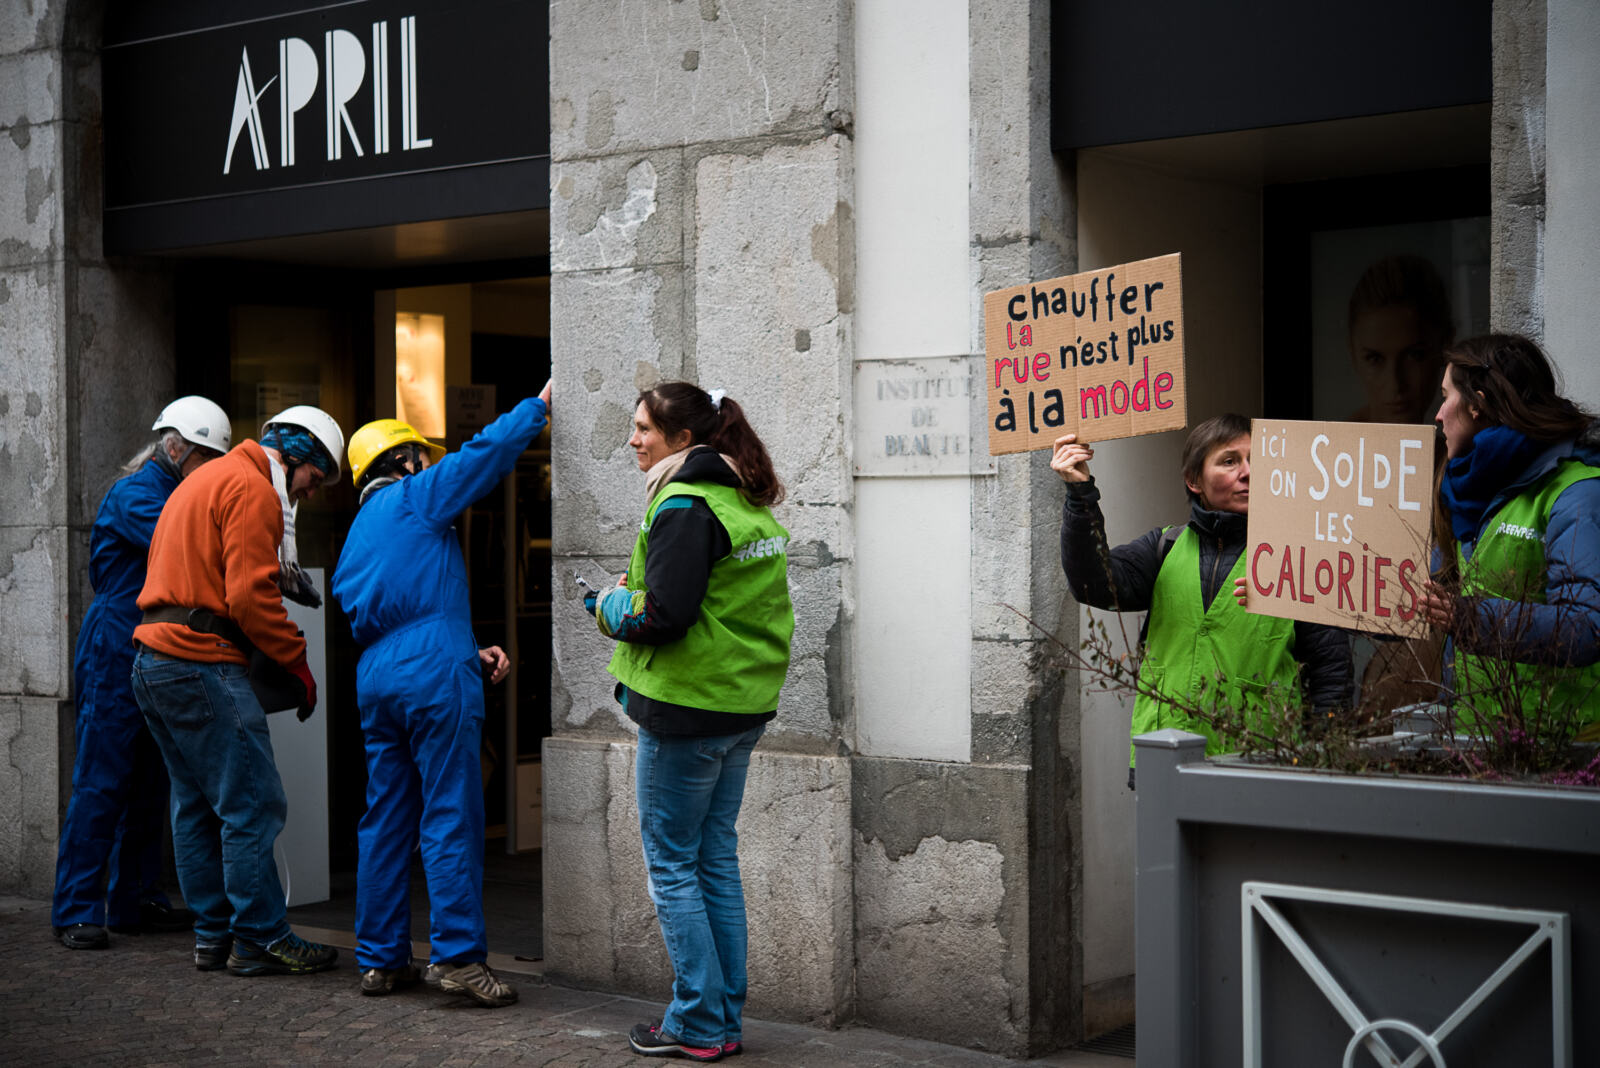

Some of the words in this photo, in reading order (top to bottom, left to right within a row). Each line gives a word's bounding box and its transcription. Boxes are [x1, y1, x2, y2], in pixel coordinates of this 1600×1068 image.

[223, 16, 433, 175] APRIL
[1008, 273, 1164, 321] chauffer
[994, 352, 1051, 388] rue
[1059, 331, 1119, 370] n'est
[1127, 315, 1174, 366] plus
[1006, 321, 1033, 350] la
[1028, 388, 1065, 434] la
[1080, 356, 1174, 419] mode
[1269, 468, 1297, 499] ON
[1308, 433, 1423, 512] SOLDE
[1314, 511, 1354, 545] LES
